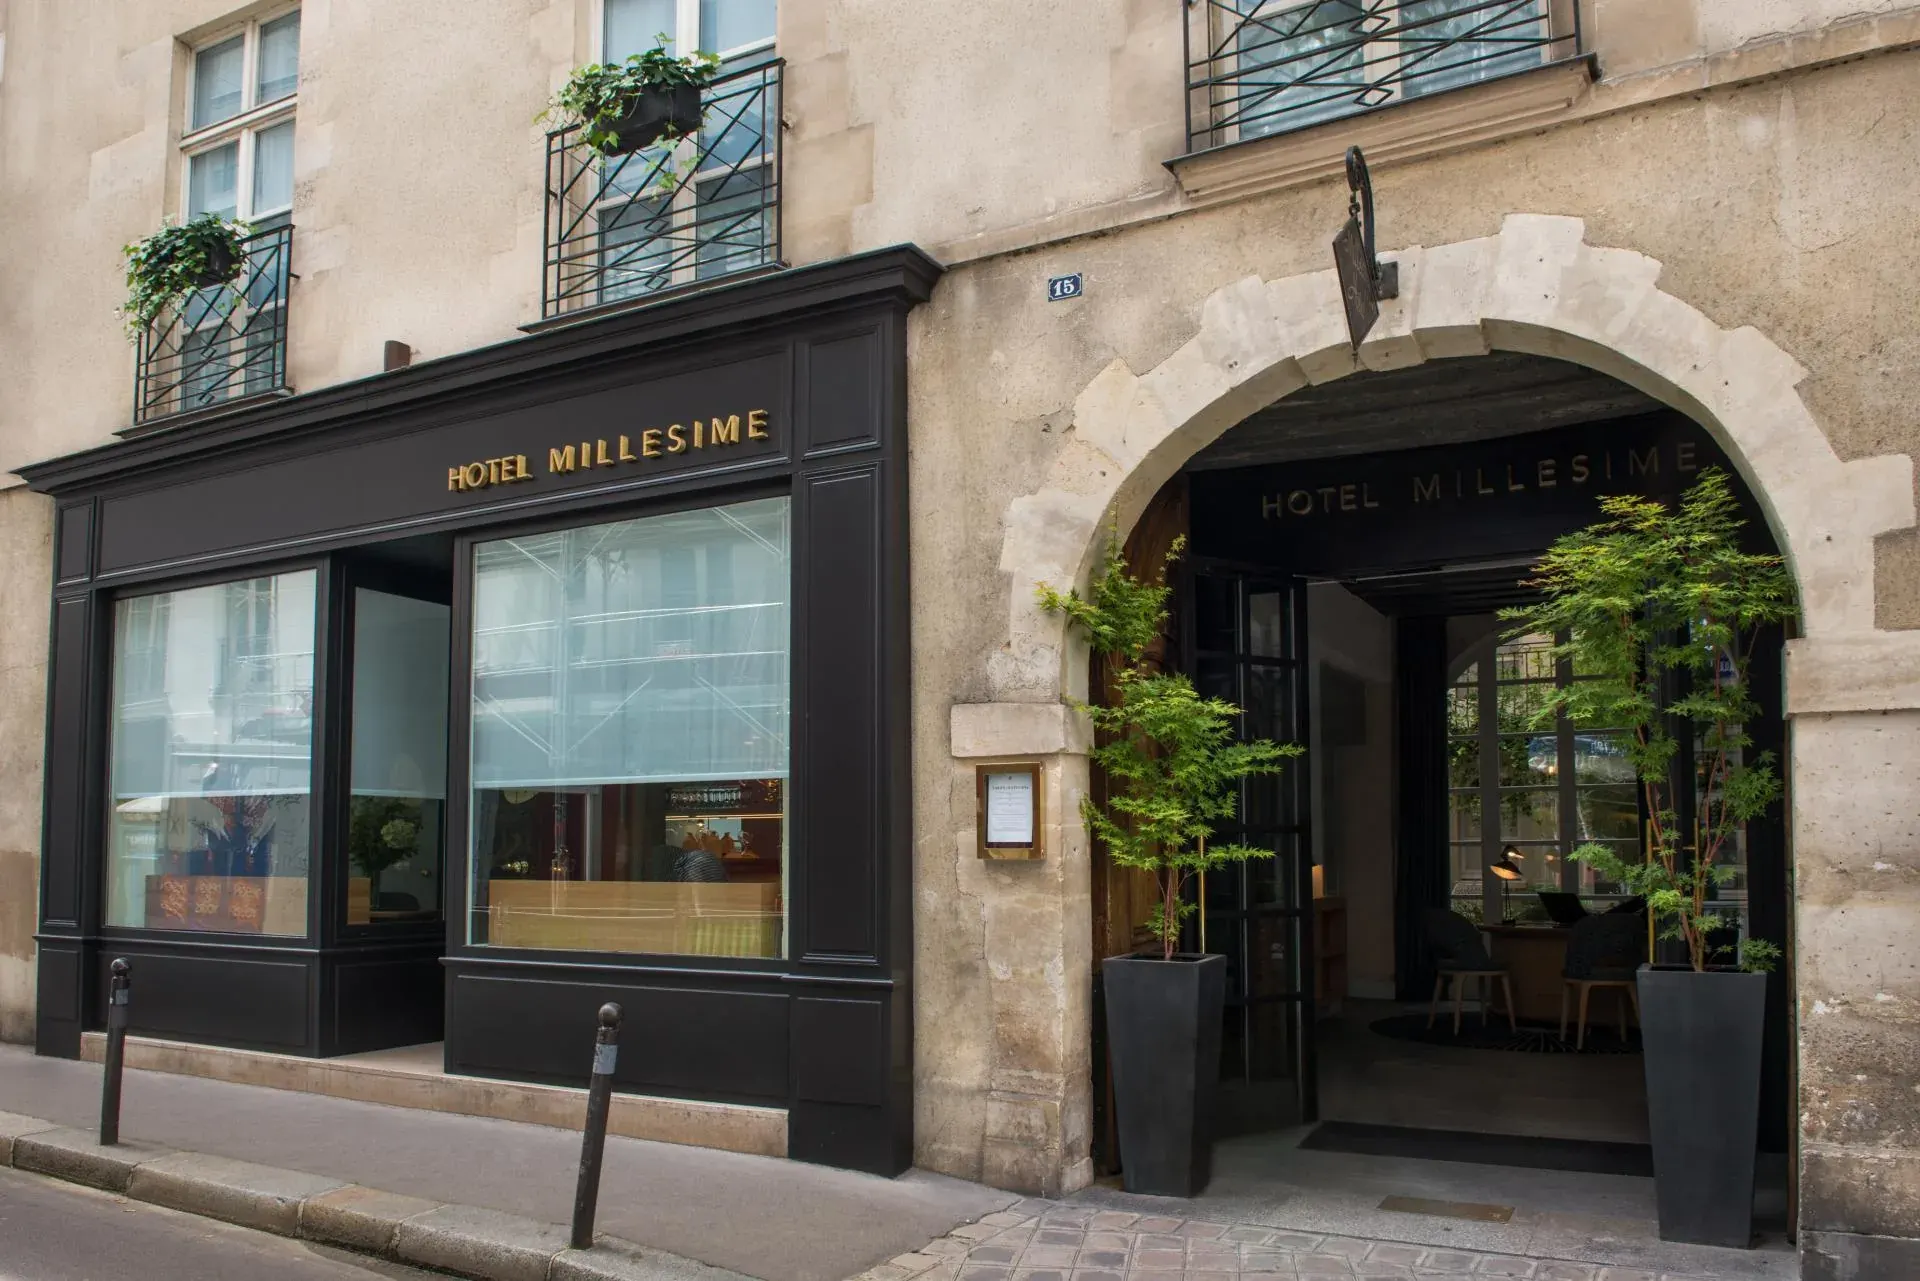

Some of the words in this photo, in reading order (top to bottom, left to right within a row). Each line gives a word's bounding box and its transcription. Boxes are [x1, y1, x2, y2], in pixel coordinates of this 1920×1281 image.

[1054, 278, 1075, 297] 15
[448, 454, 534, 492] HOTEL
[549, 408, 769, 473] MILLESIME
[1261, 482, 1380, 520] HOTEL
[1412, 441, 1698, 503] MILLESIME
